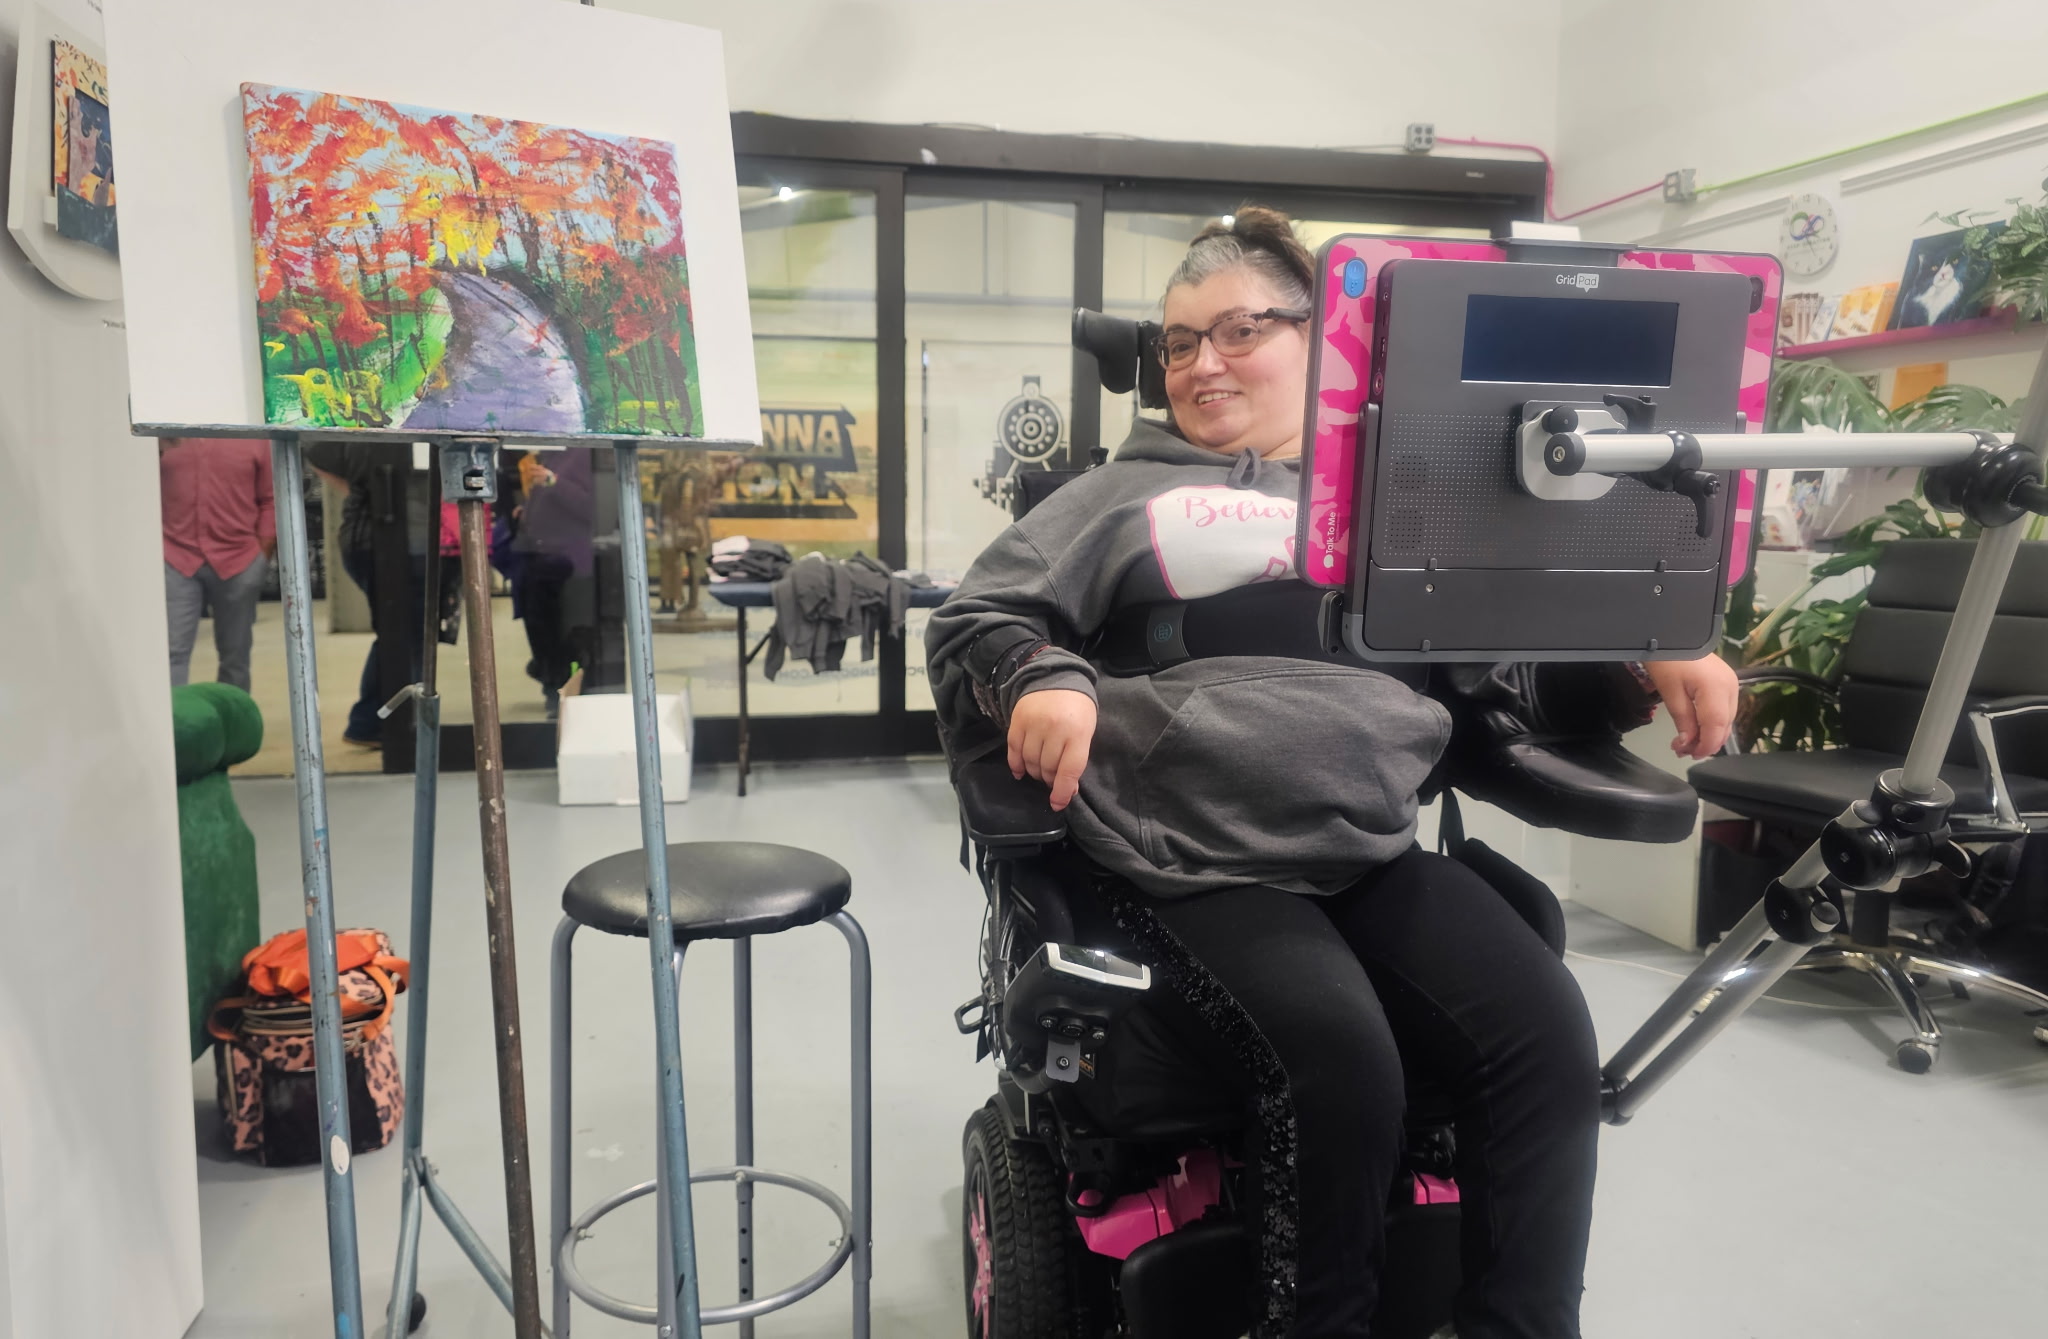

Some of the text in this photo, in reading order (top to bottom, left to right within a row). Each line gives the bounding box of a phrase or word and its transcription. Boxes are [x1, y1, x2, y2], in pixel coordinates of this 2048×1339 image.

[761, 412, 843, 458] NNA
[1176, 495, 1297, 528] Believ
[1326, 511, 1336, 554] Talk To Me
